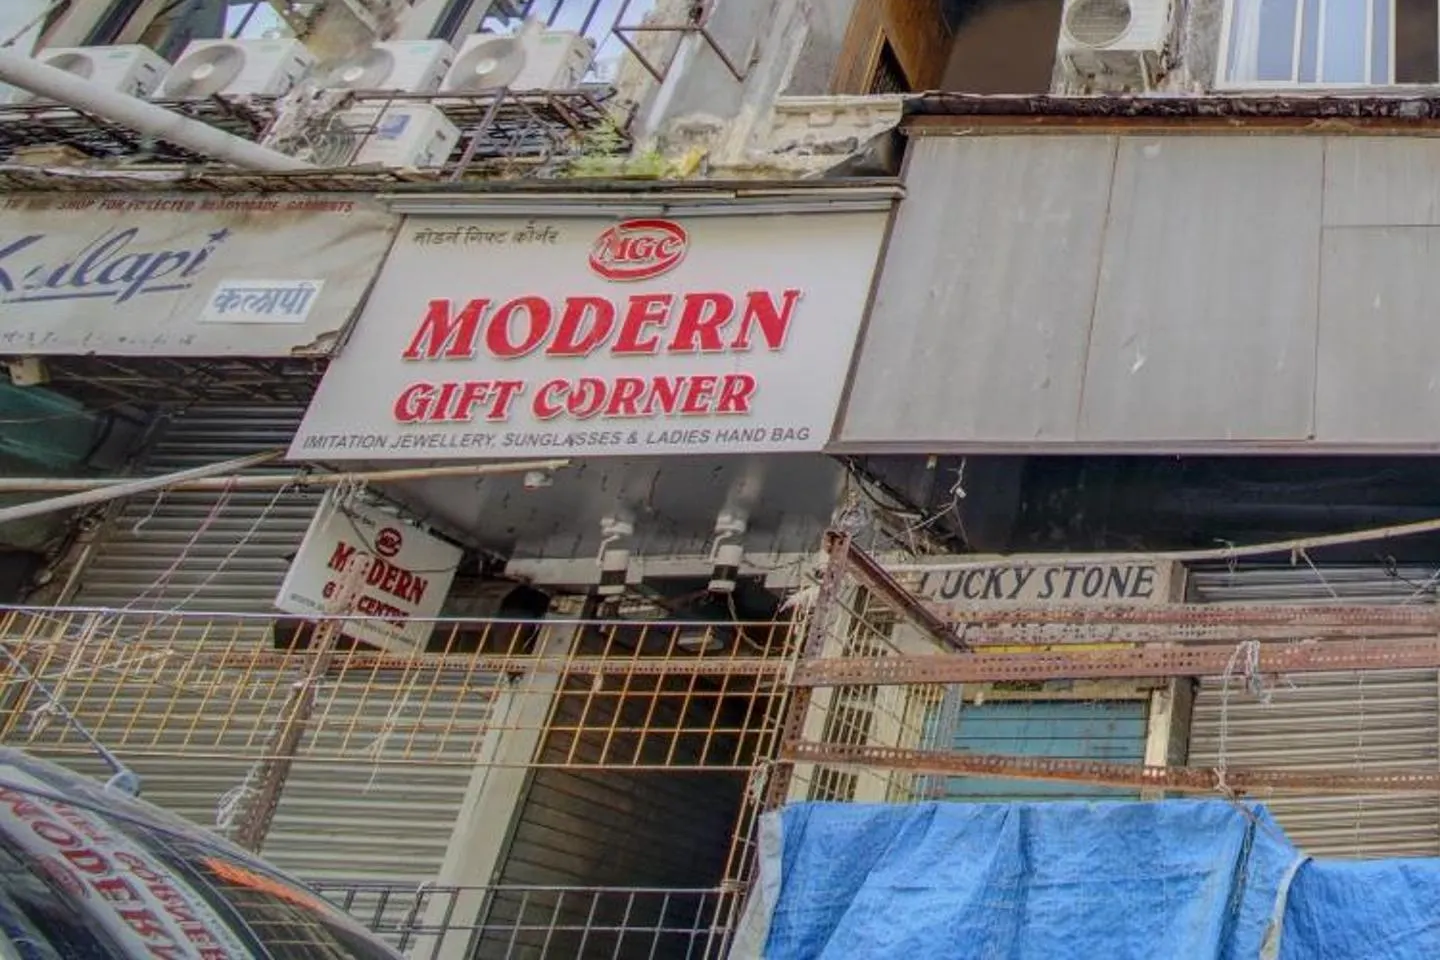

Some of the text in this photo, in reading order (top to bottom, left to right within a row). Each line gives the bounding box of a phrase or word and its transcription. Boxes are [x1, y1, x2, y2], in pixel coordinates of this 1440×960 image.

[402, 288, 802, 362] MODERN
[392, 375, 757, 424] GIFT CORNER
[303, 426, 811, 450] IMITATION JEWELLERY, SUNGLASSES & LADIES HAND BAG
[917, 565, 1156, 600] LUCKY STONE
